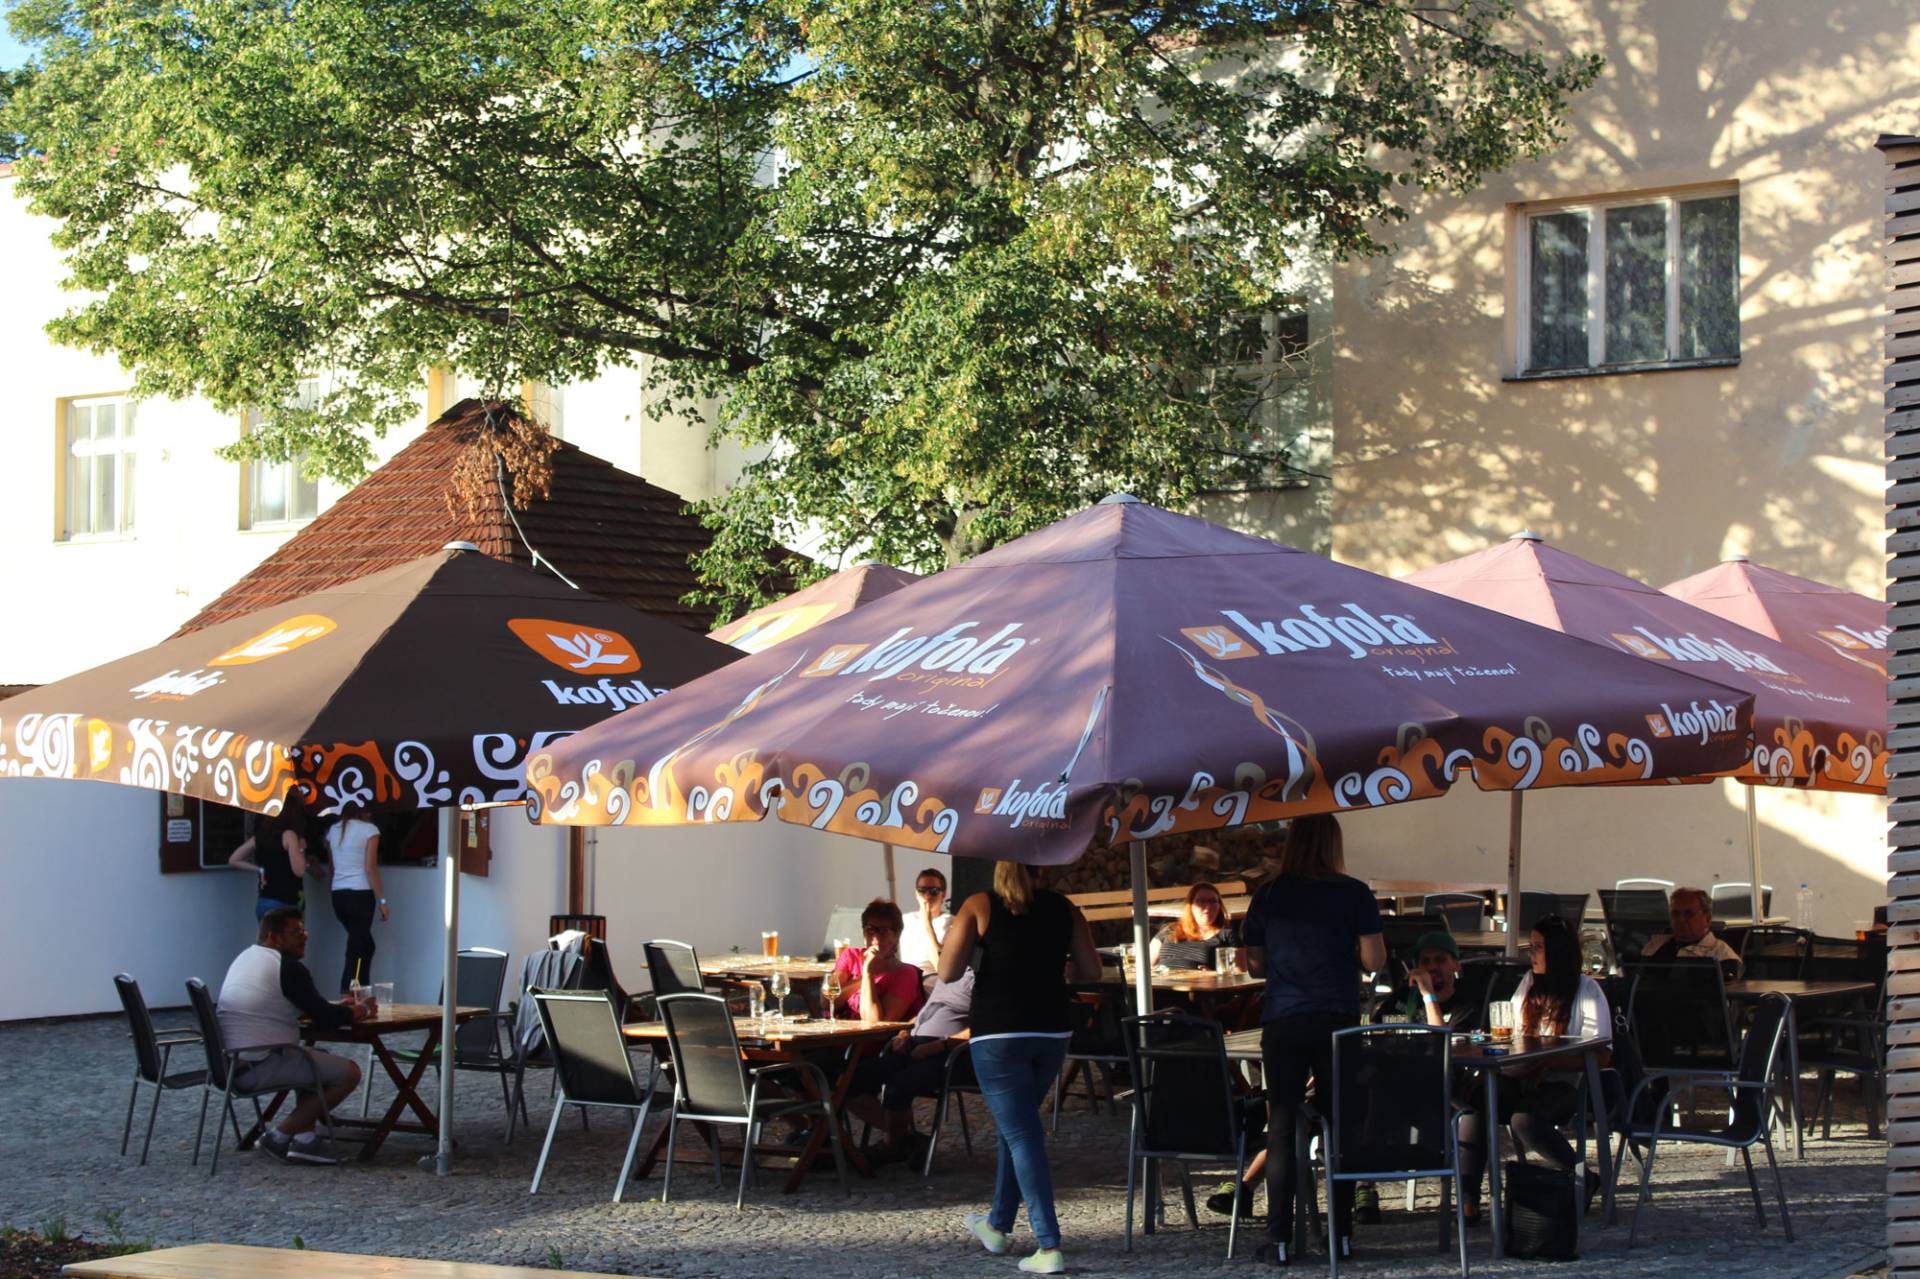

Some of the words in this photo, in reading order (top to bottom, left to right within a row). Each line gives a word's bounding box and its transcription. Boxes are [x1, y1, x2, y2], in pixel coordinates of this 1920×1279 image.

[838, 621, 1024, 682] kofola
[1220, 603, 1437, 659] kofola
[1370, 637, 1460, 664] original
[1632, 626, 1789, 673] kofola
[896, 667, 1009, 695] original
[1660, 700, 1737, 746] kofola
[991, 779, 1067, 828] kofola
